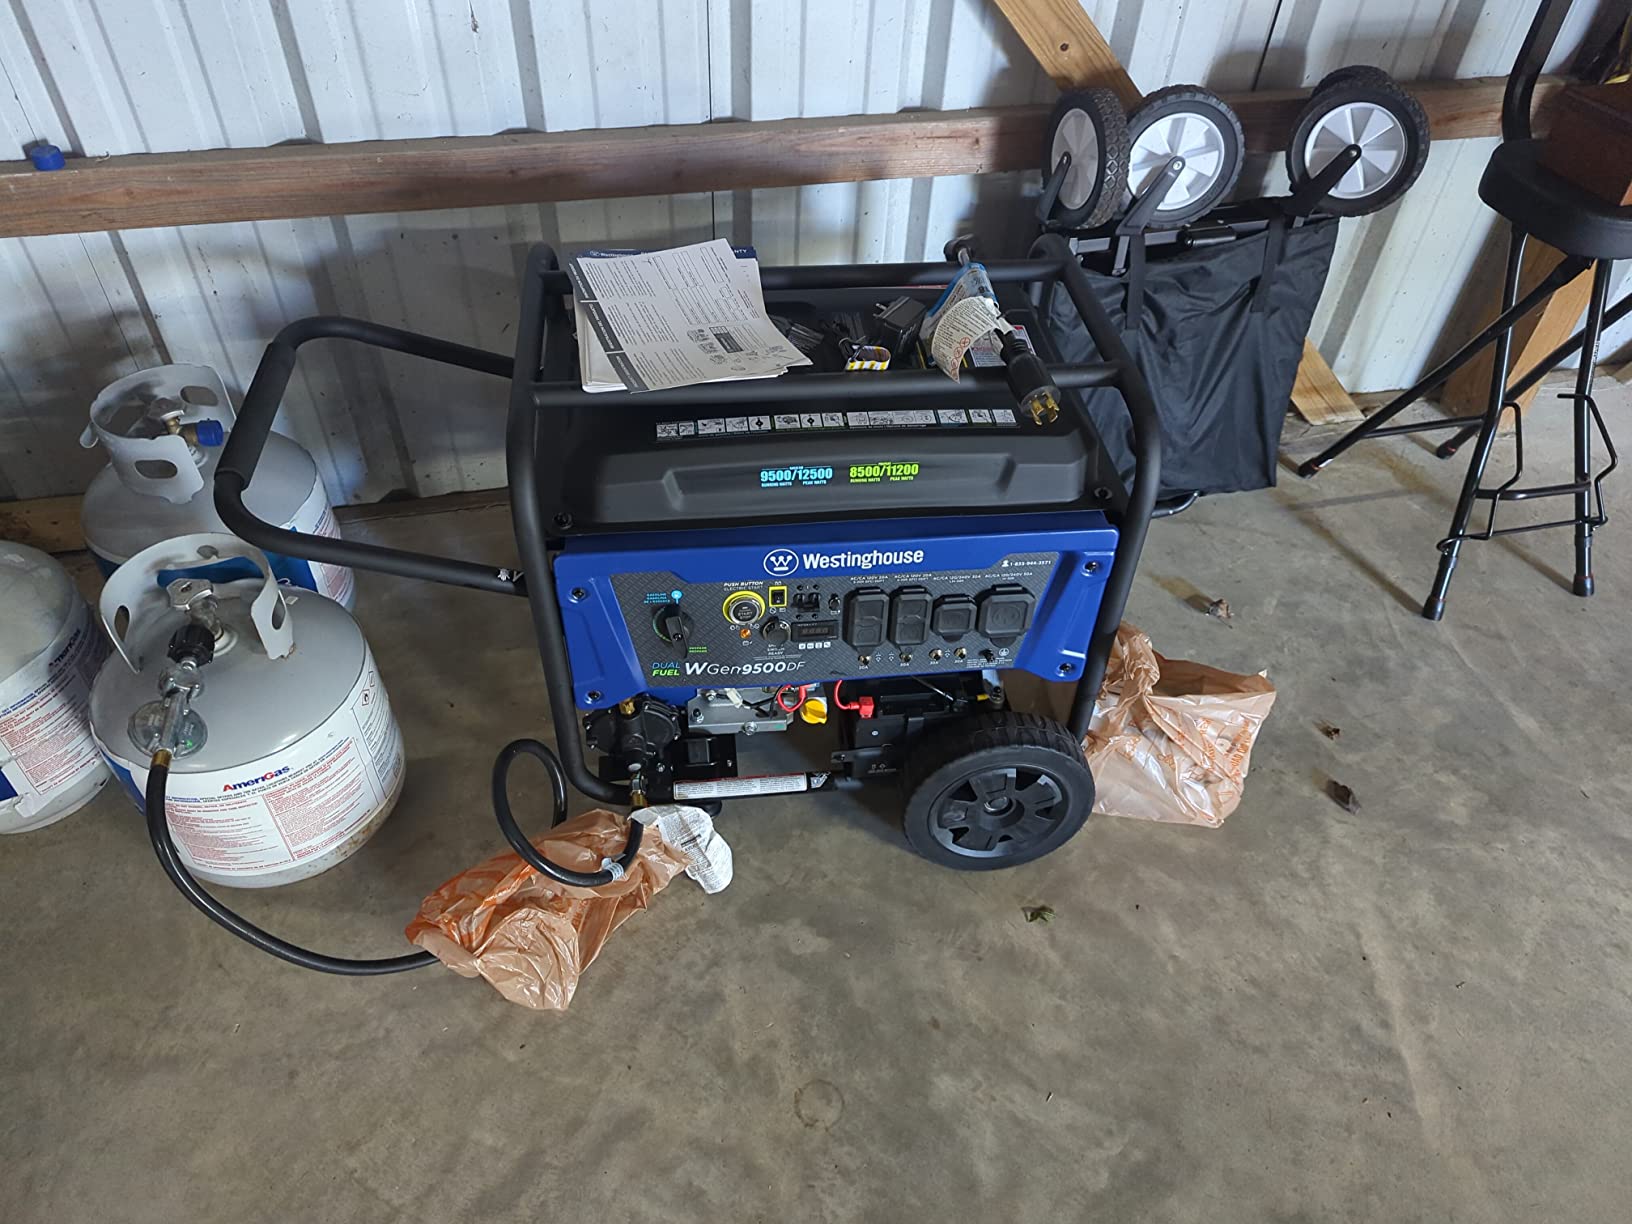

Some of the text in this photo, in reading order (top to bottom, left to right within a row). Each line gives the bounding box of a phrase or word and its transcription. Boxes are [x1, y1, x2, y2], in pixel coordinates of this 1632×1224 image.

[760, 468, 833, 482] 9500/12500
[849, 464, 919, 478] 8500/11200
[802, 549, 925, 570] Westinghouse
[652, 669, 680, 677] FUEL
[222, 765, 291, 793] AmeriGas
